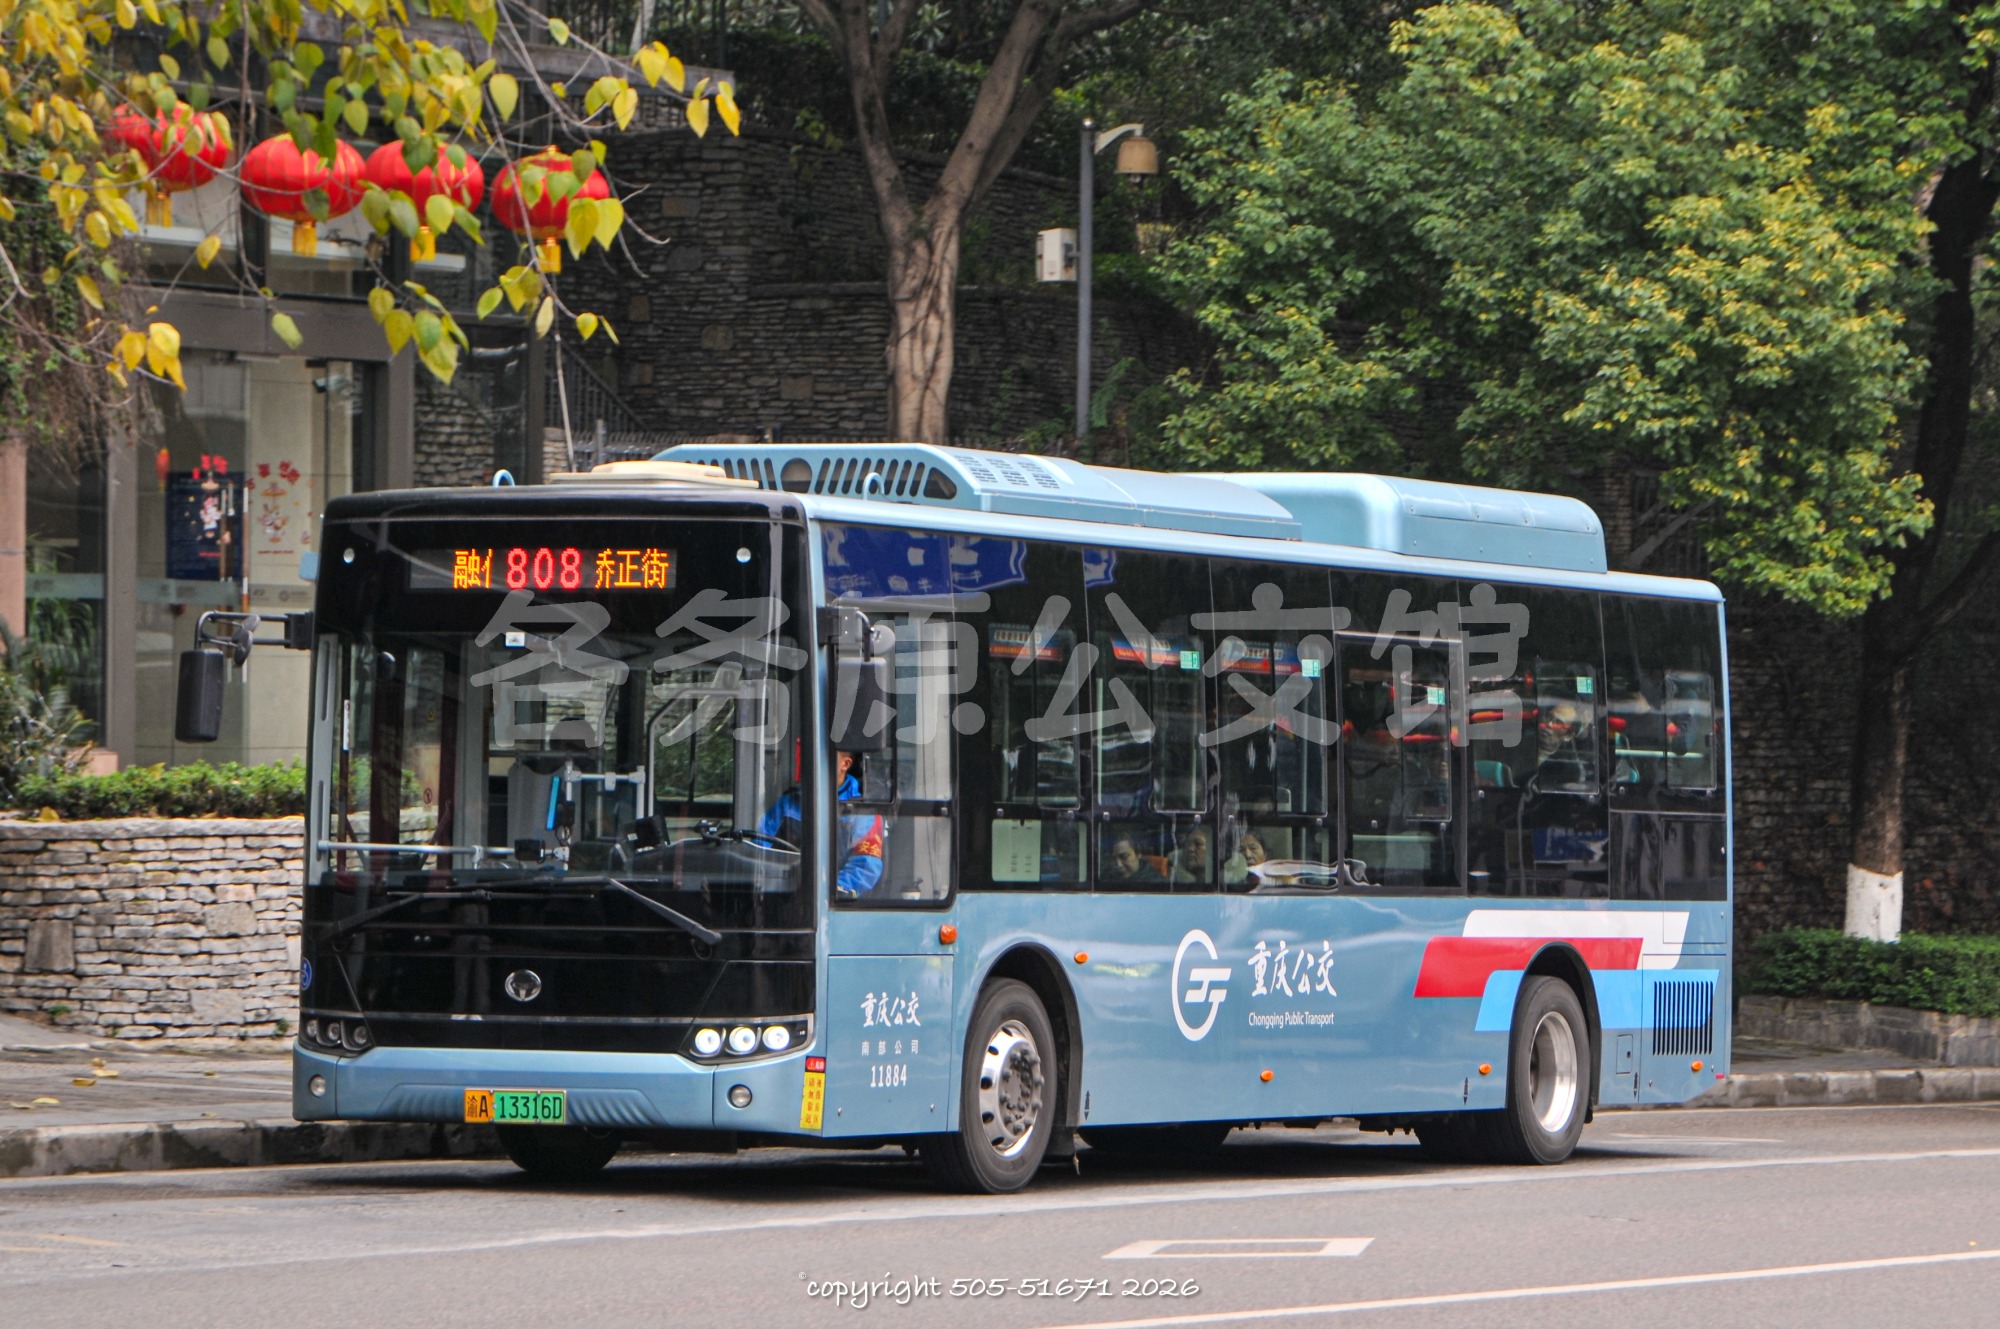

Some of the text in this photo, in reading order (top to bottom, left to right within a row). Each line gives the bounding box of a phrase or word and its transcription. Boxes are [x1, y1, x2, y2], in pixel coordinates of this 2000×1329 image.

[506, 548, 582, 590] 808
[1247, 940, 1338, 997] 重庆公交
[860, 991, 921, 1028] 重庆公交
[1248, 1011, 1334, 1029] Chongqing Public Transport
[861, 1039, 919, 1056] 南部公司
[870, 1064, 907, 1088] 11884
[467, 1095, 562, 1119] 渝A 13316D
